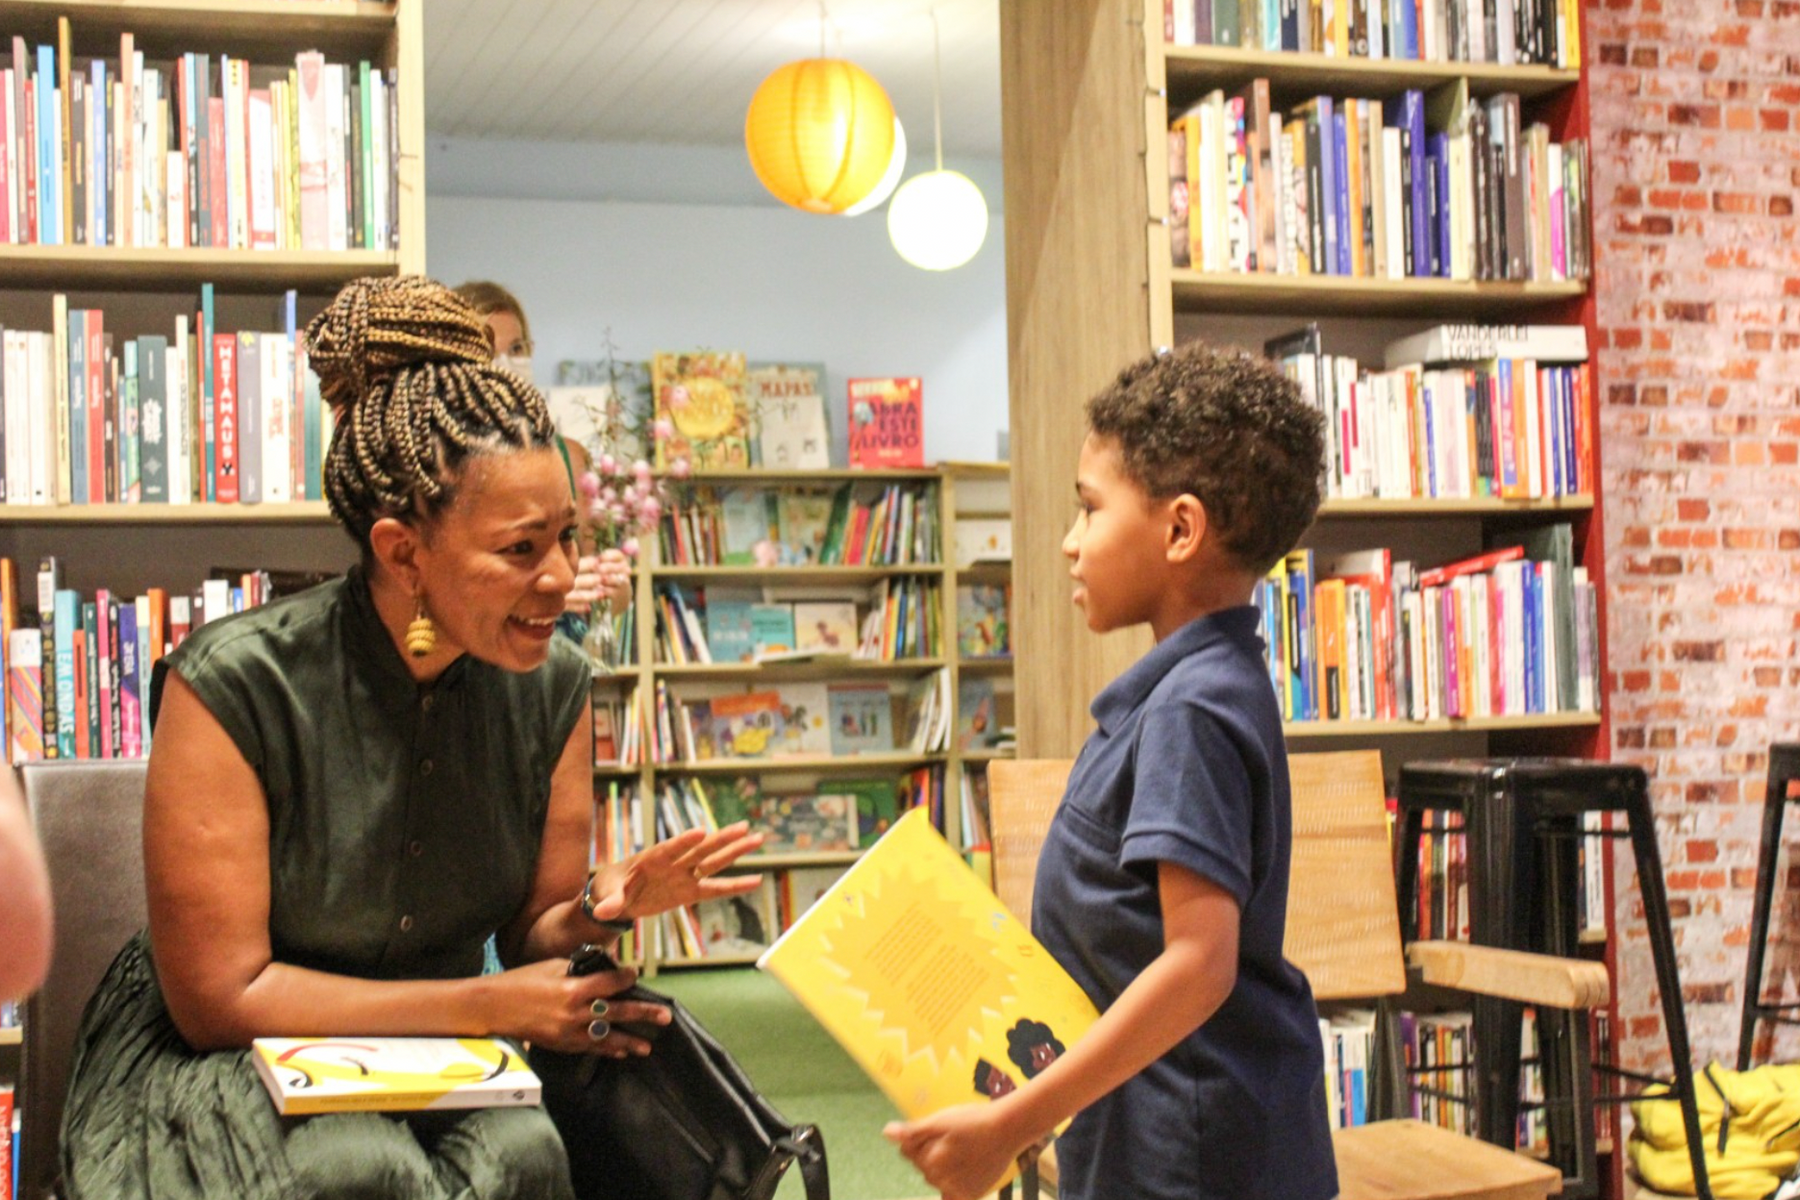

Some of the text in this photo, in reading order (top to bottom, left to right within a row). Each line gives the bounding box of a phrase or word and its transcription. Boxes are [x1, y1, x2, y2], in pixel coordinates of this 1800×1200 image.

[219, 346, 234, 460] METAMAUS
[760, 381, 813, 398] MAPAS
[863, 434, 919, 450] LIVRO
[56, 651, 75, 734] EM ONDAS
